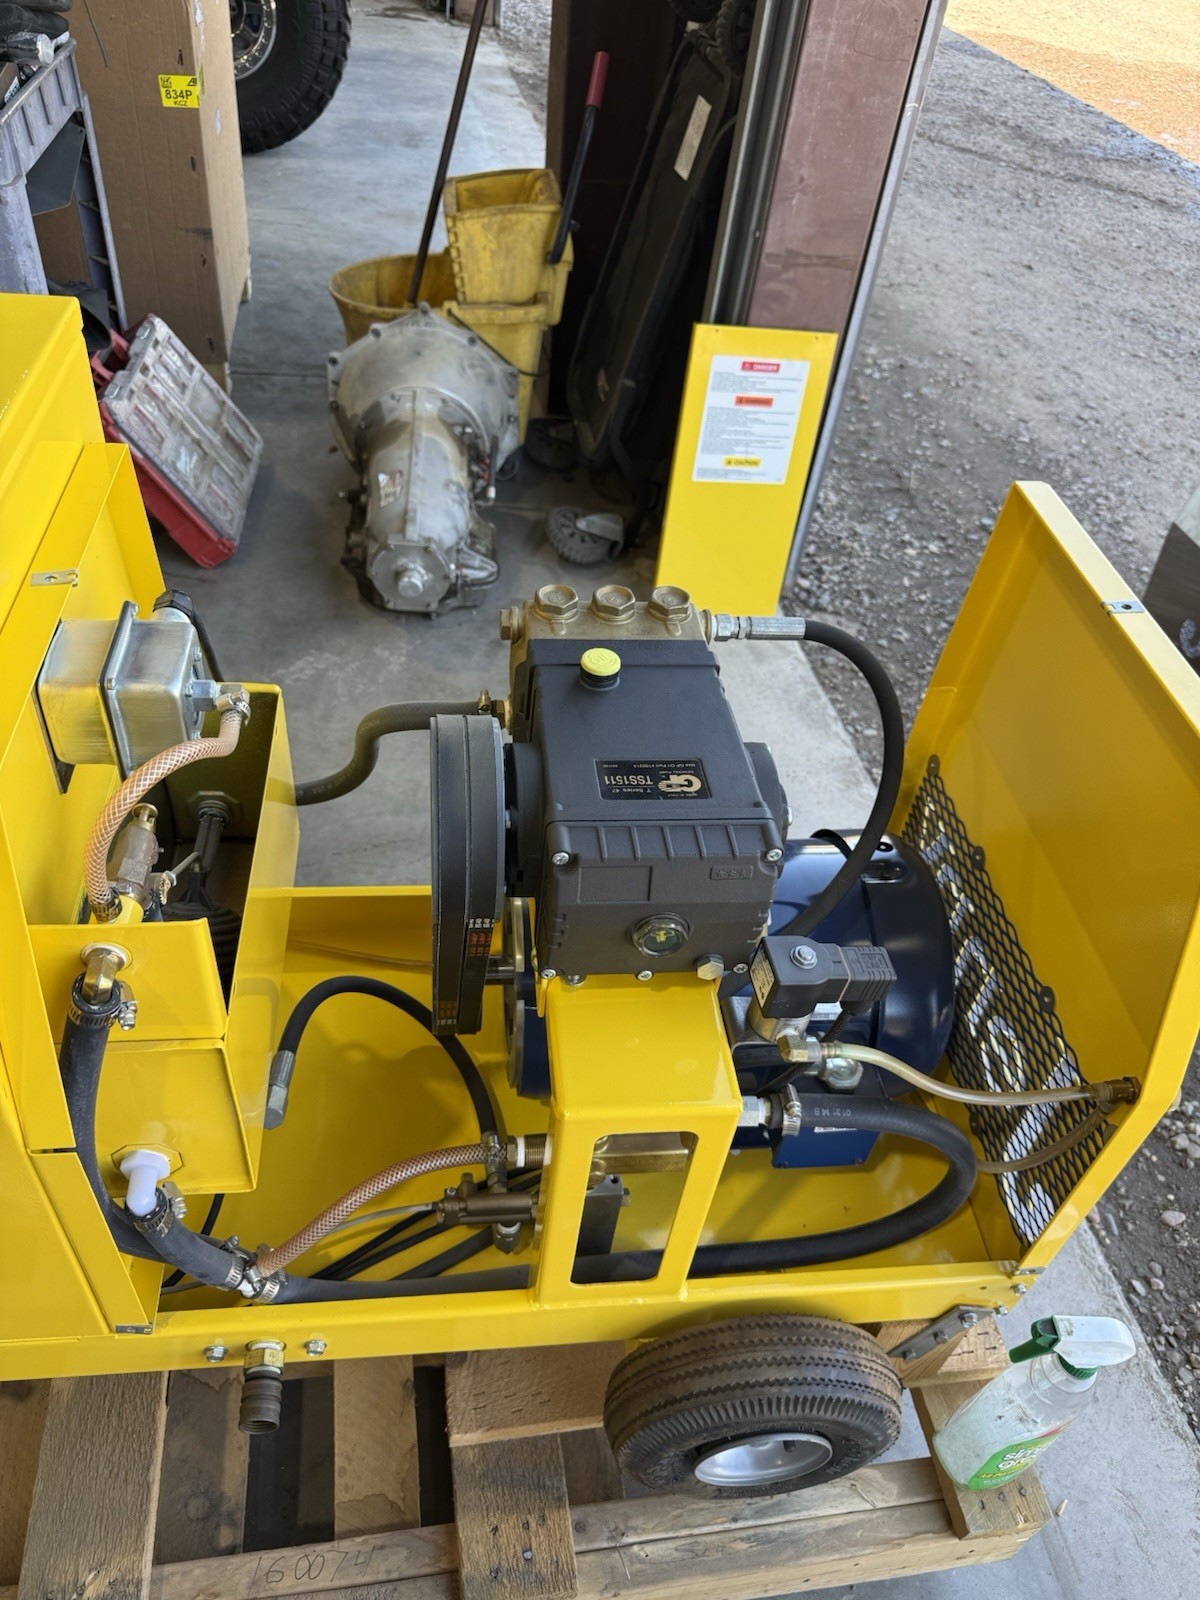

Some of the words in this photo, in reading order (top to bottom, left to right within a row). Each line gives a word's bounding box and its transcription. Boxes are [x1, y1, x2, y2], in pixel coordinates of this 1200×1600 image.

[165, 89, 192, 99] 834P
[733, 458, 759, 466] CAUTION
[604, 775, 653, 785] TSS1511
[658, 774, 702, 793] GP
[248, 1545, 376, 1598] 160074
